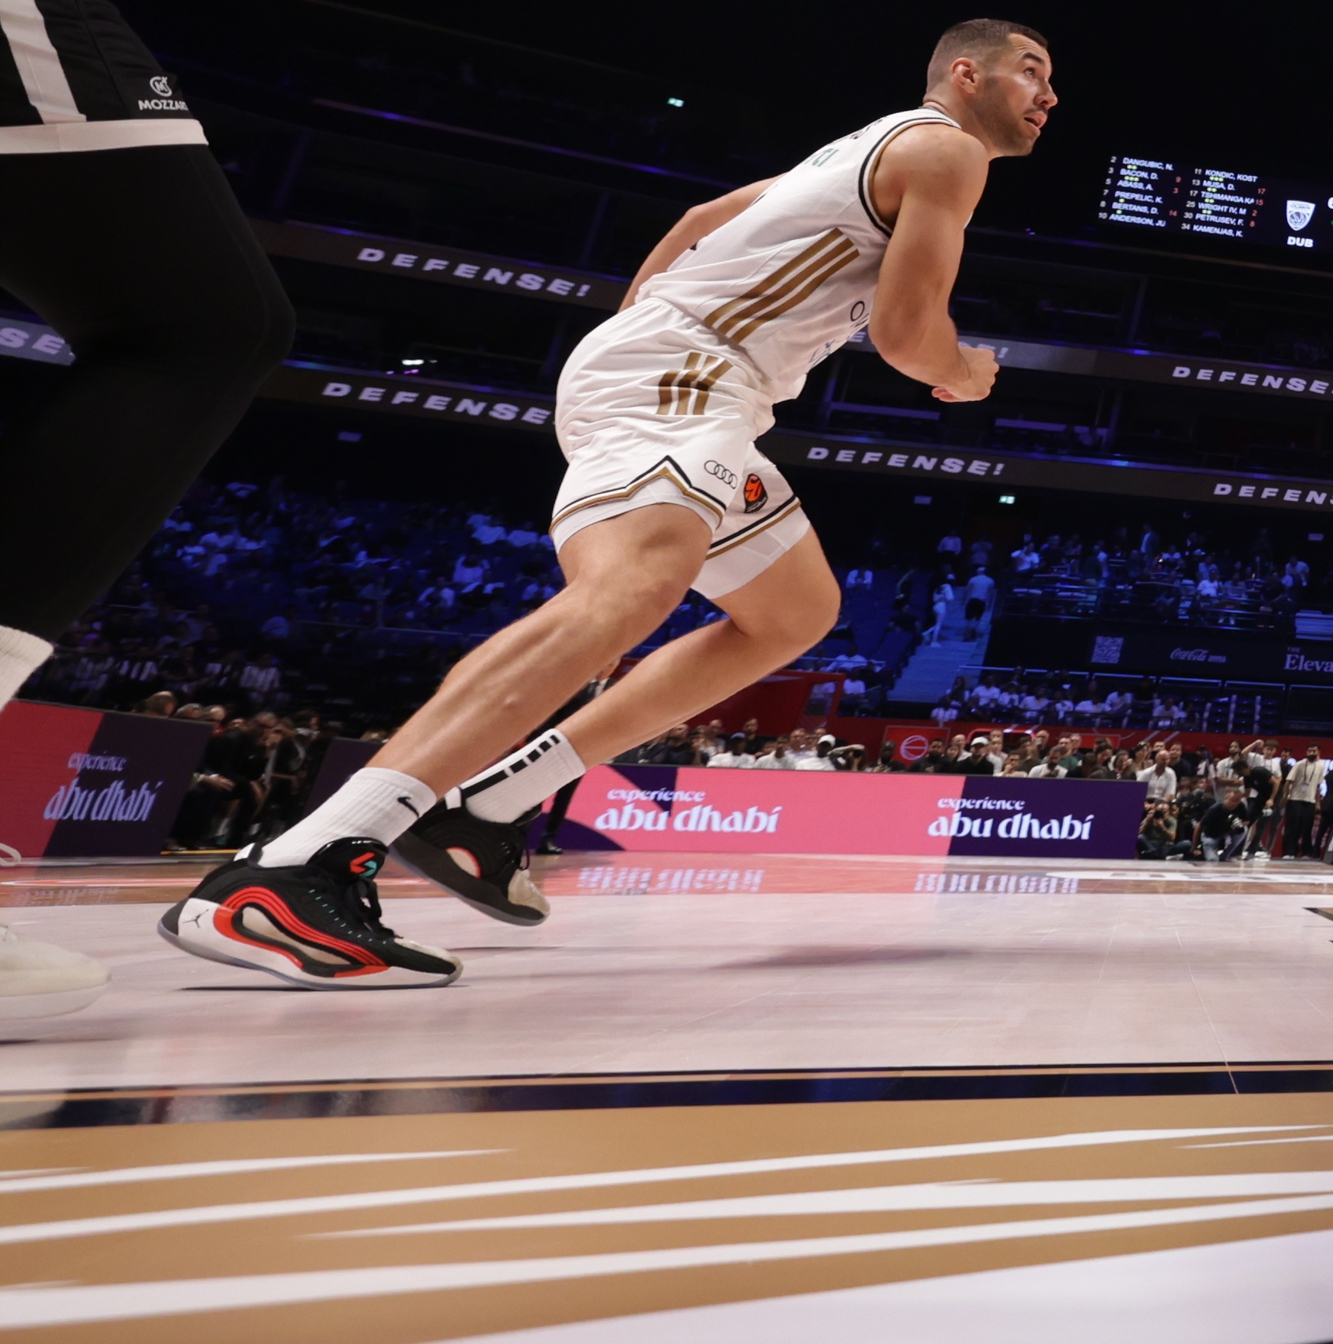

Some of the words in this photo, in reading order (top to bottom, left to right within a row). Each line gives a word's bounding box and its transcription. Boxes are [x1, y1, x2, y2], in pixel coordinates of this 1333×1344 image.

[1287, 236, 1313, 247] DUB
[357, 246, 591, 299] DEFENSE!
[806, 446, 1006, 477] DEFENSE!
[43, 776, 96, 821] abu
[607, 787, 707, 803] experience
[937, 797, 1026, 812] experience
[594, 803, 671, 832] abu
[927, 810, 997, 838] abu
